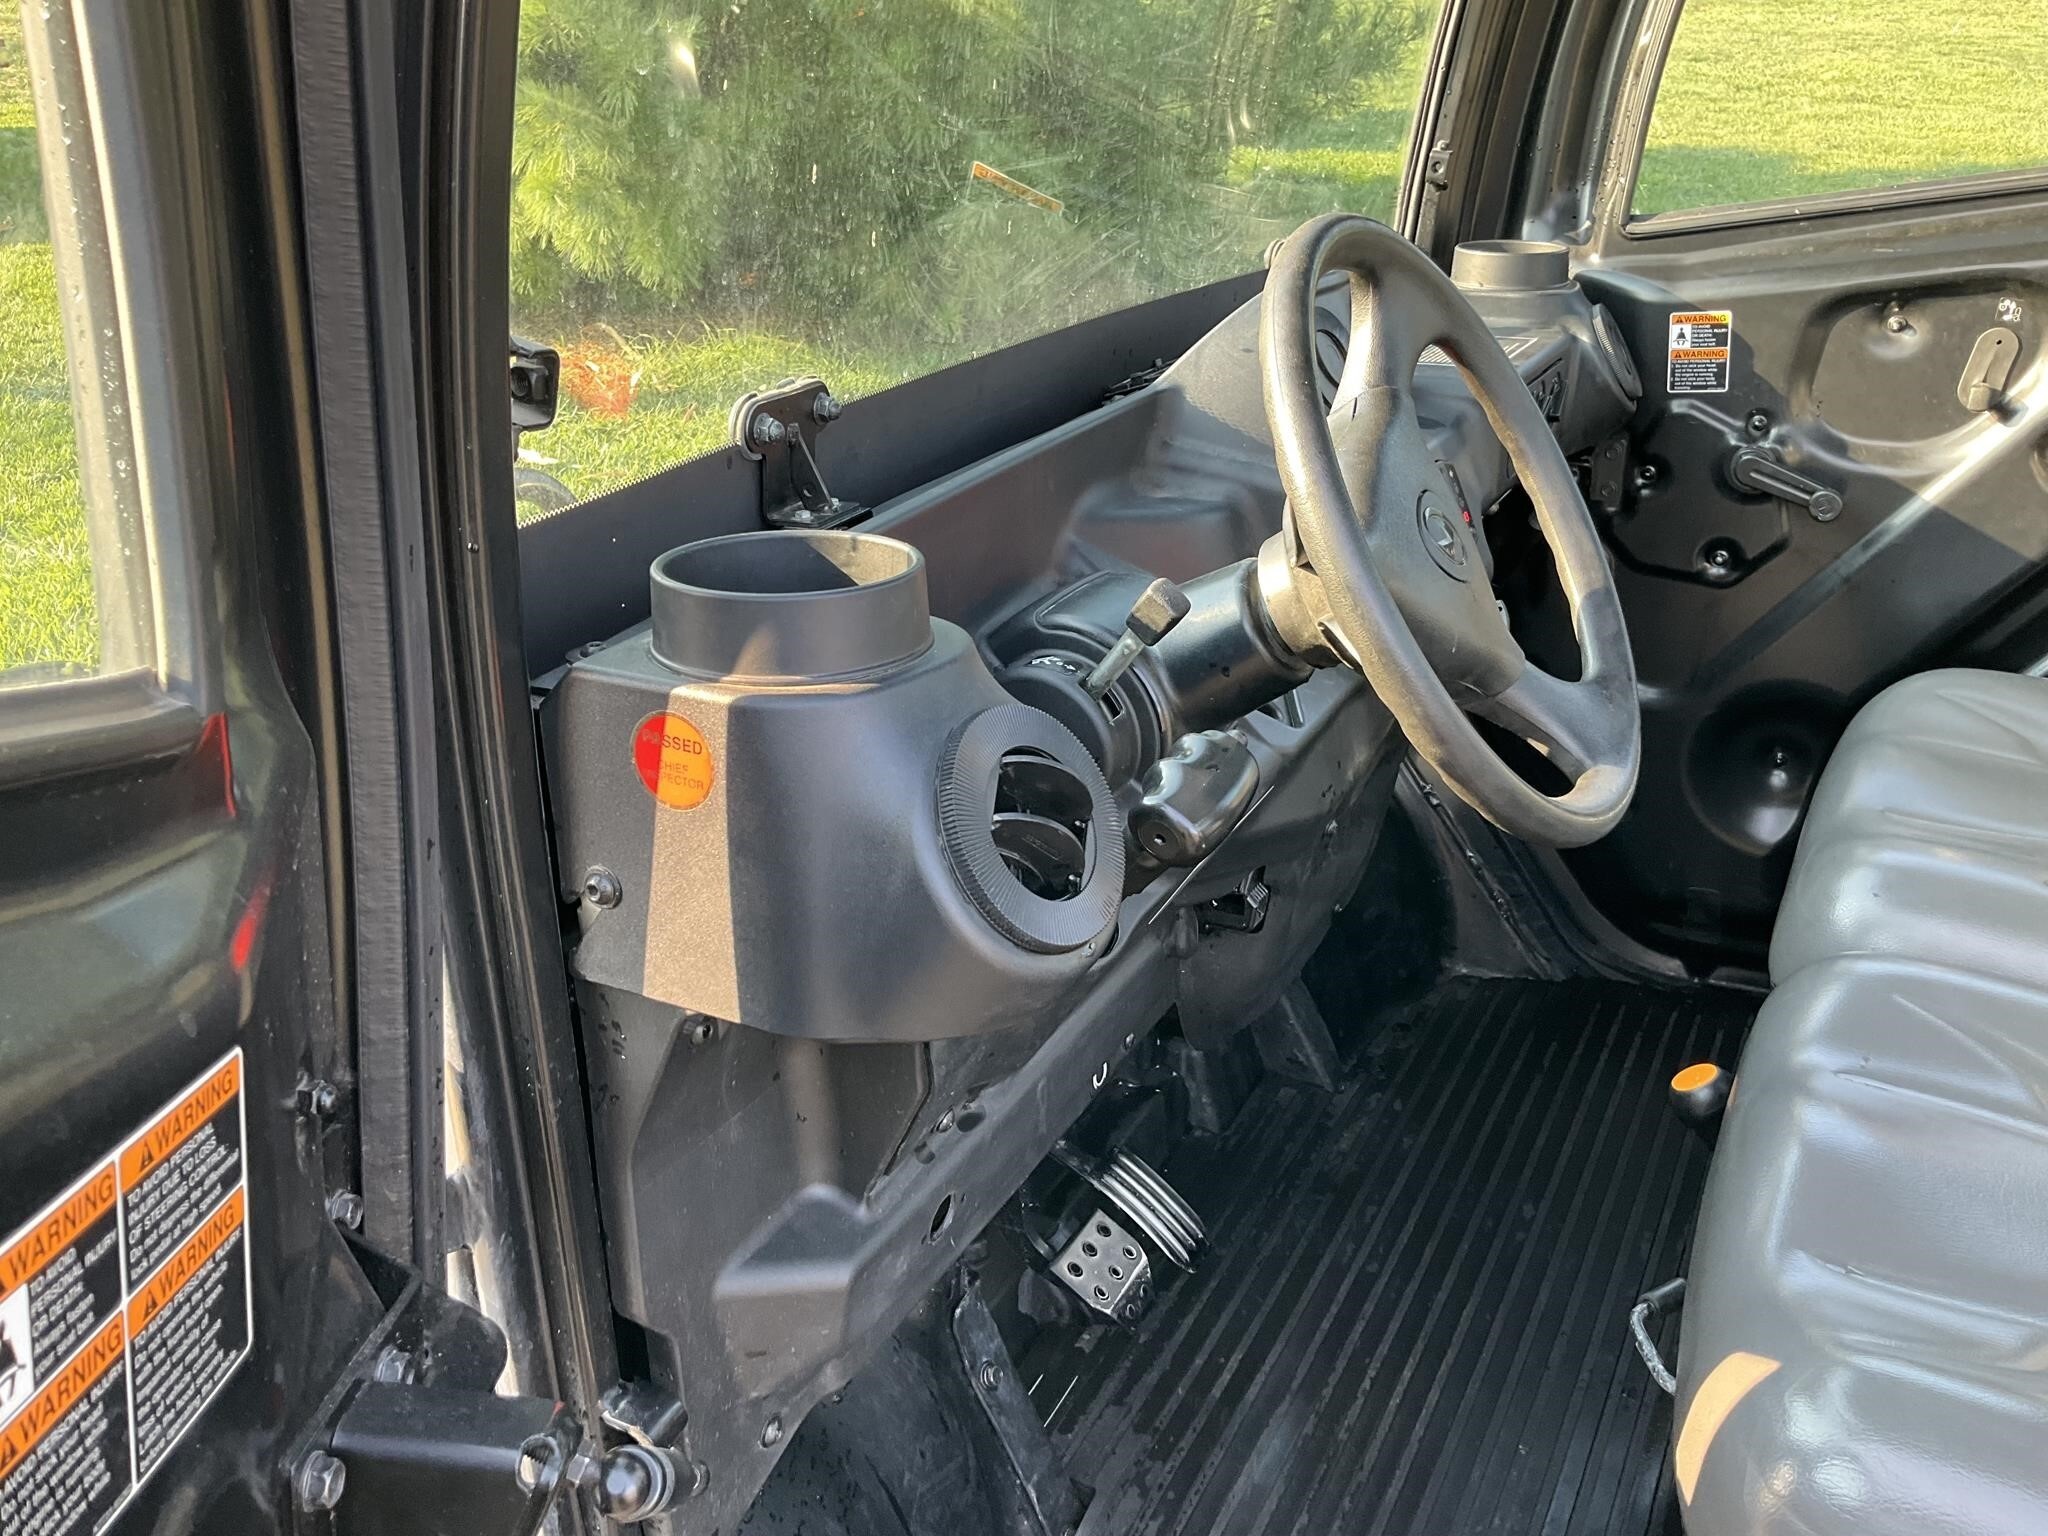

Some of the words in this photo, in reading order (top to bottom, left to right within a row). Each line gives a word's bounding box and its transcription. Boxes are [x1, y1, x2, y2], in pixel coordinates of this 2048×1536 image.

[155, 1069, 232, 1153] WARNING
[127, 1188, 142, 1207] TO
[142, 1162, 169, 1195] AVOID
[170, 1123, 214, 1168] PERSONAL
[128, 1188, 161, 1226] INJURY
[162, 1169, 181, 1195] DUE
[182, 1157, 194, 1175] TO
[194, 1136, 217, 1164] LOSS
[9, 1174, 113, 1281] WARNING
[128, 1223, 142, 1245] OF
[144, 1181, 188, 1230] STEERING
[130, 1245, 143, 1264] Do
[159, 1204, 234, 1298] WARNING
[29, 1275, 45, 1297] TO
[45, 1248, 76, 1284] AVOID
[30, 1263, 84, 1318] PERSONAL
[32, 1314, 49, 1338] OR
[20, 1324, 121, 1443] WARNING
